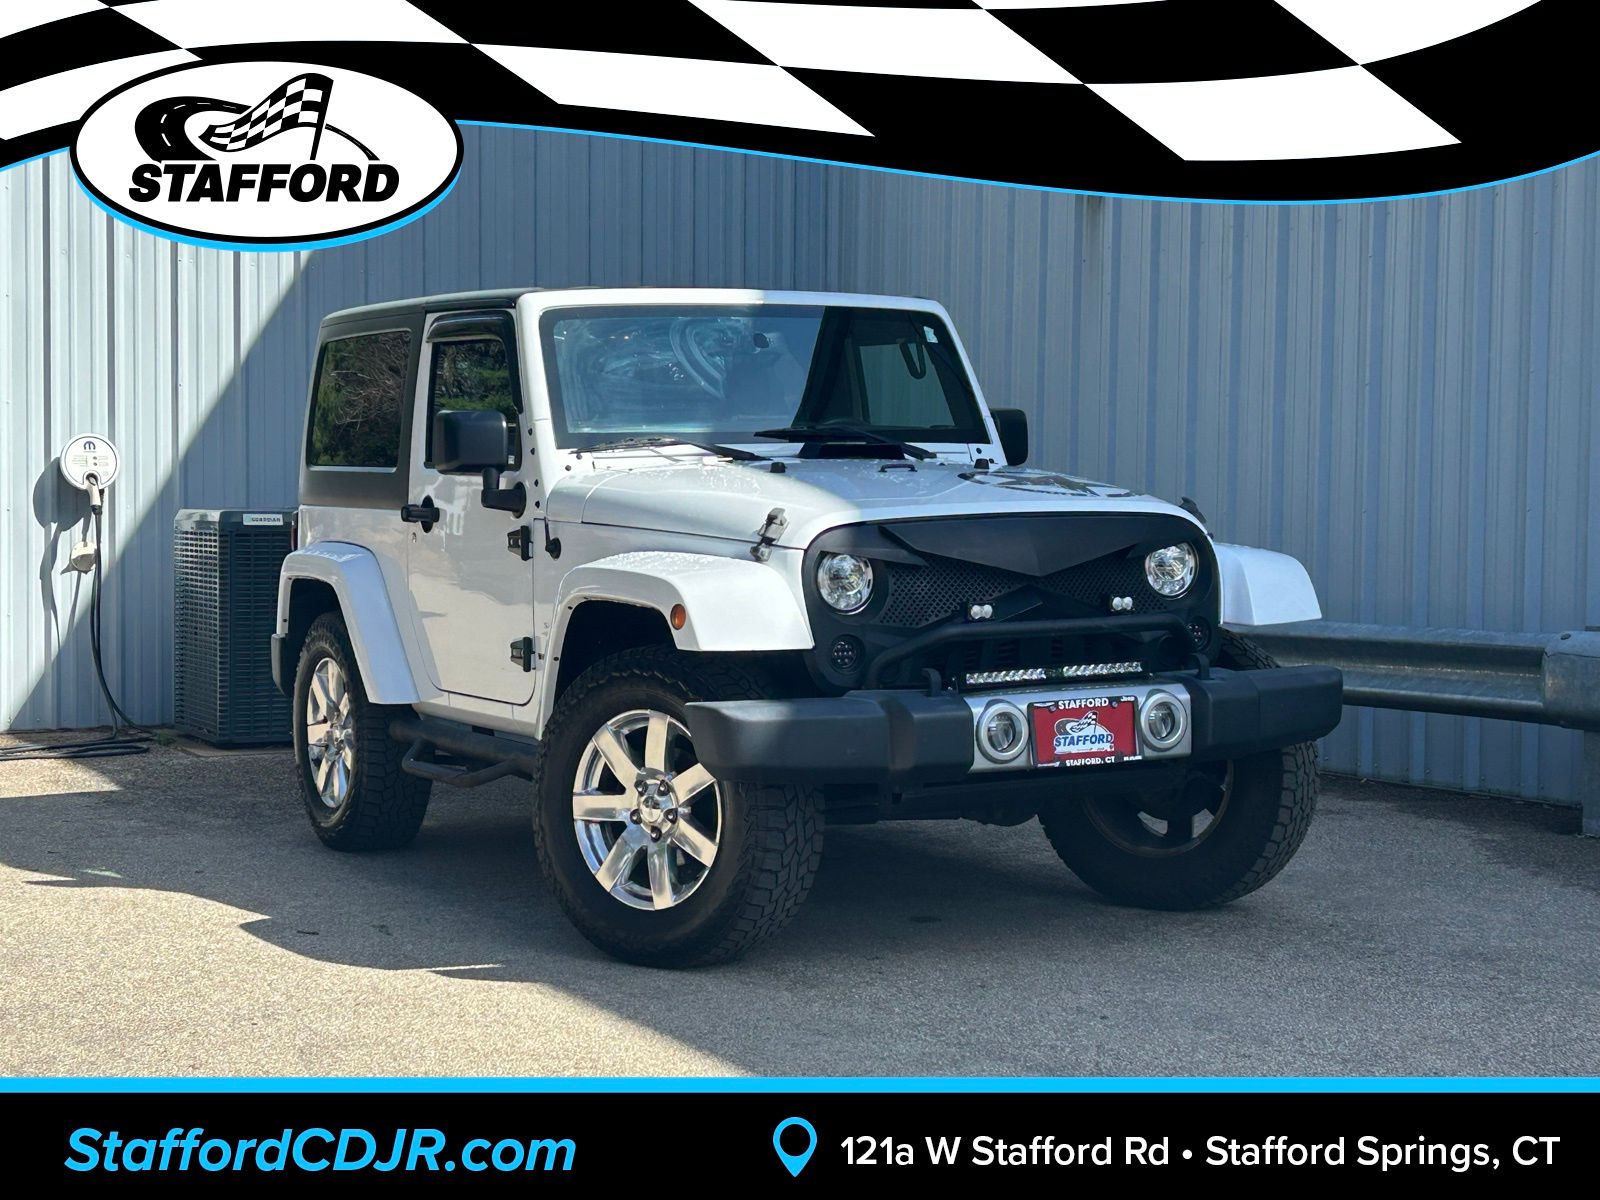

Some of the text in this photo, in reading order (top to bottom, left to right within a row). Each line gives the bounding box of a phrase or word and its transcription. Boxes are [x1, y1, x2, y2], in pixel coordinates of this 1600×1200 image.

[1058, 698, 1109, 710] STAFFORD
[1054, 733, 1113, 747] STAFFORD
[1105, 755, 1115, 764] CT
